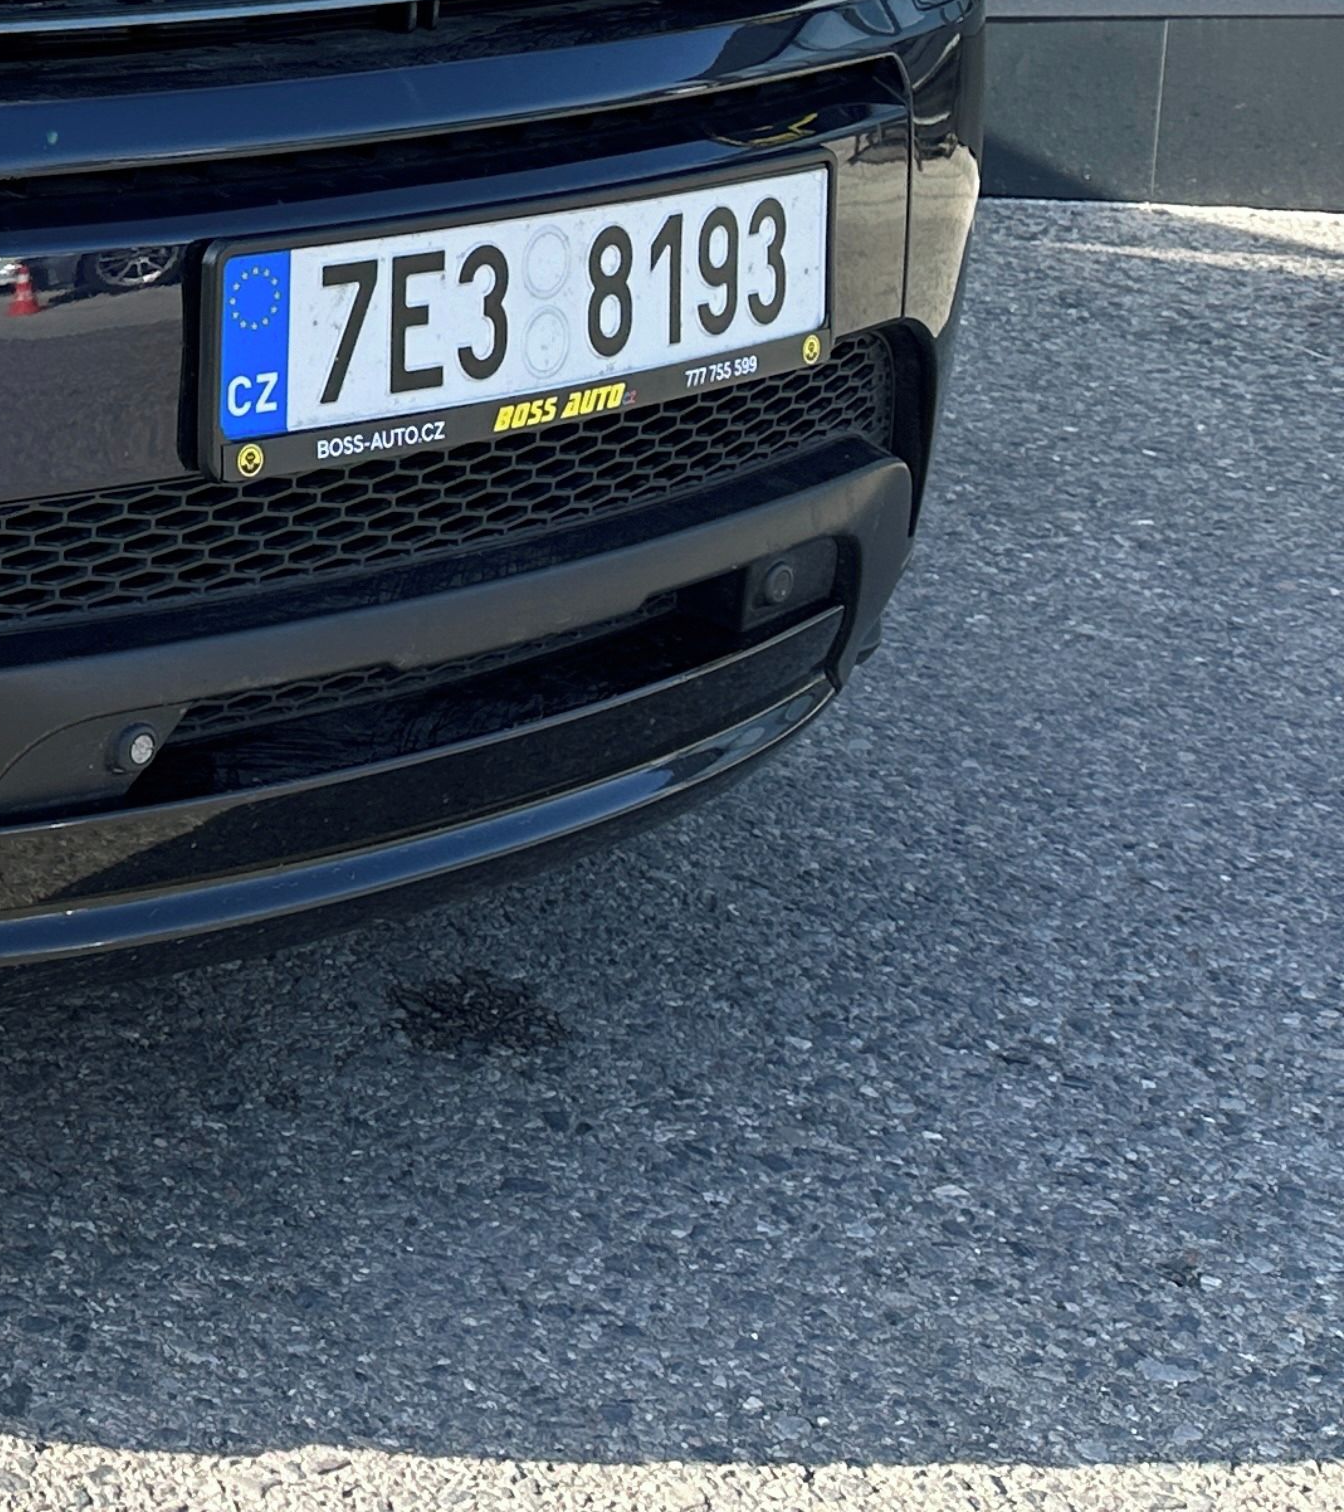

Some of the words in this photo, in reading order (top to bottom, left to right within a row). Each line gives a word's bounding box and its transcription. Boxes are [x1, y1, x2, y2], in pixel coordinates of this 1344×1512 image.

[318, 243, 510, 405] 7E3
[586, 196, 787, 360] 8193
[227, 371, 280, 418] CZ
[684, 367, 707, 387] 777
[709, 361, 732, 383] 755
[734, 356, 758, 378] 599
[493, 396, 558, 432] BOSS
[560, 382, 627, 419] AUTO
[316, 421, 446, 459] BOSS-AUTO.CZ
